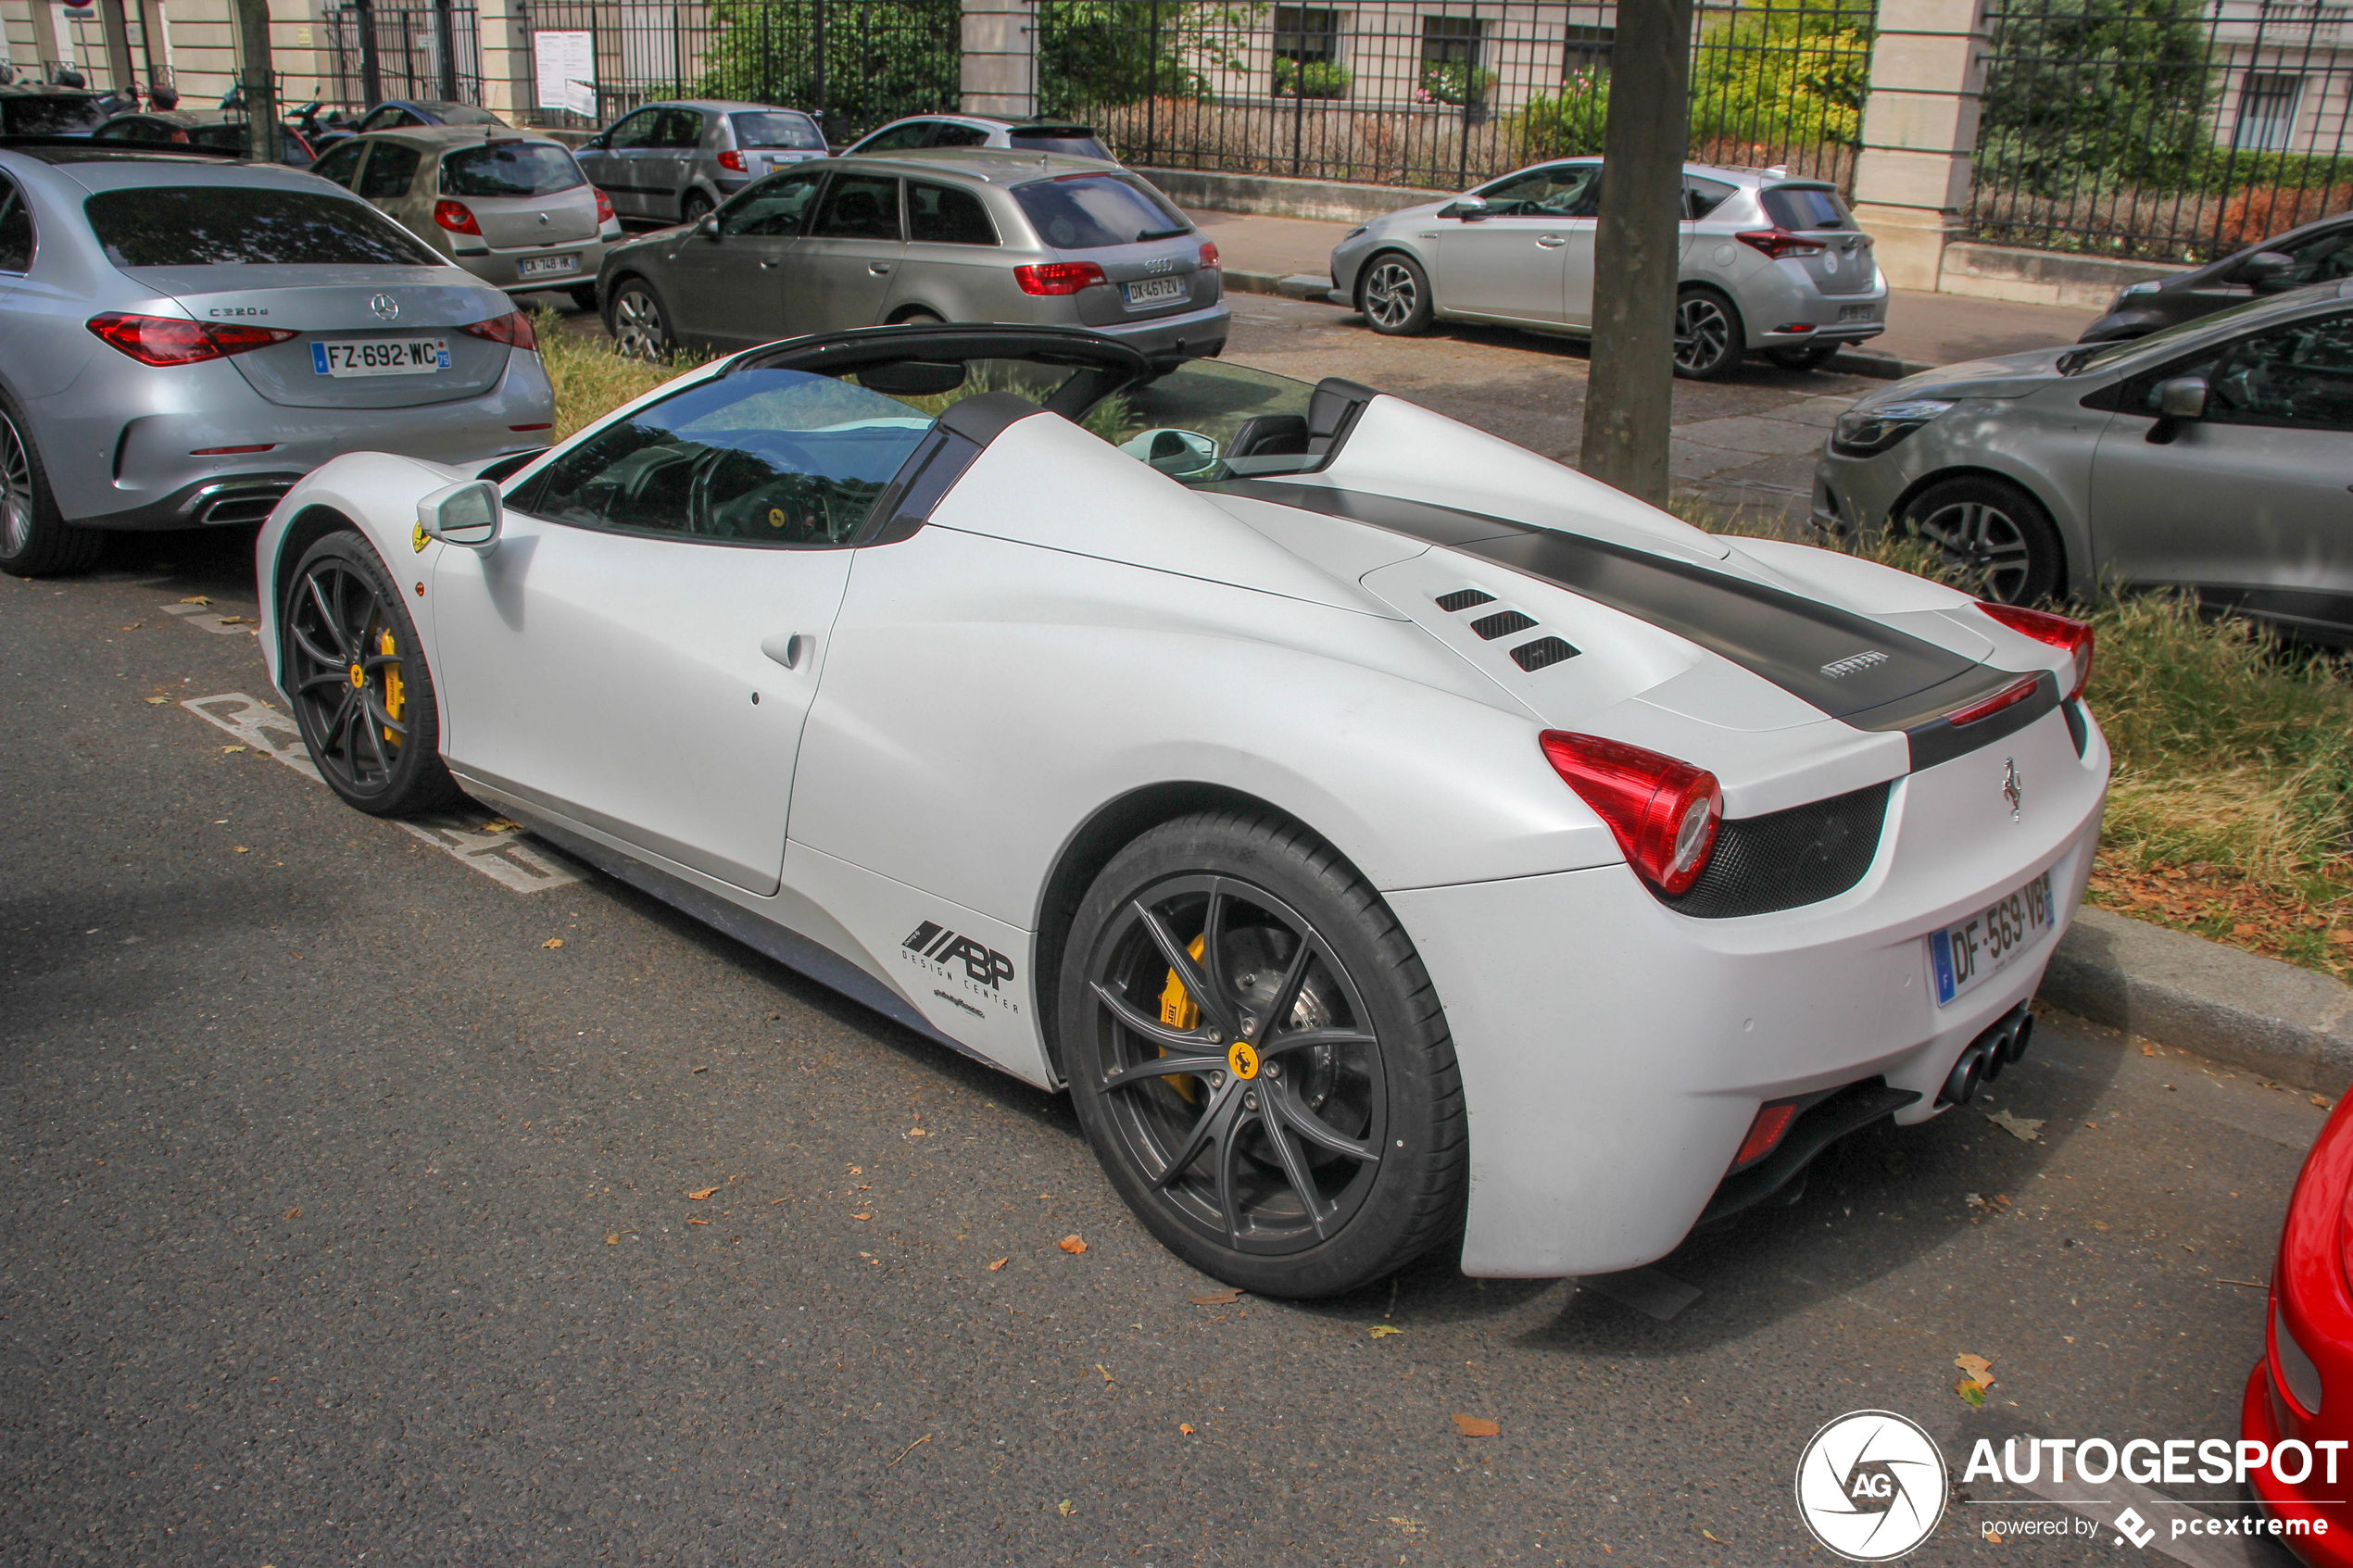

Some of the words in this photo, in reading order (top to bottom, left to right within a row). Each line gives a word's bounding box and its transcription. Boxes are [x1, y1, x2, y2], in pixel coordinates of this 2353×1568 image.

[524, 257, 571, 271] CA-748-HK
[1130, 279, 1177, 299] DX-461-ZV
[327, 343, 437, 369] FZ-692-WC
[438, 354, 449, 366] 75
[1951, 877, 2045, 985] DF-569-VB
[901, 949, 953, 982] DESIGN
[963, 980, 1020, 1014] CENTER
[934, 935, 1015, 991] ABP
